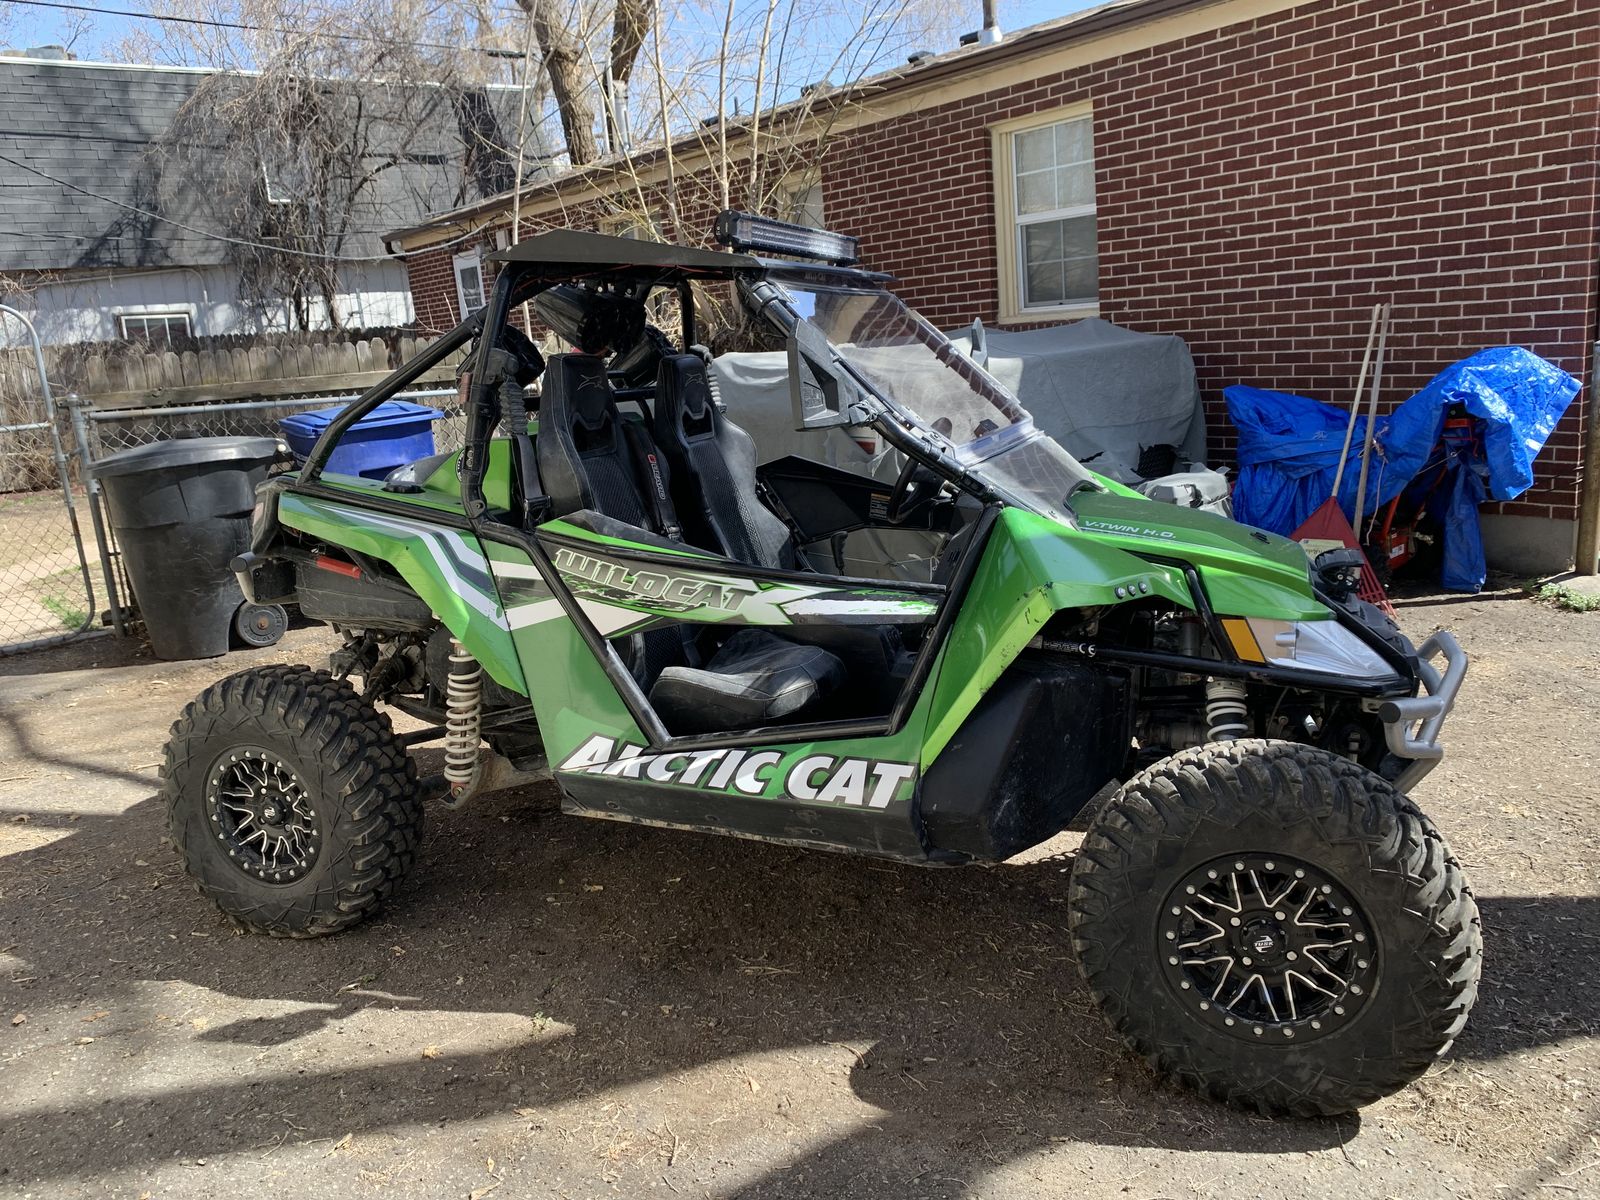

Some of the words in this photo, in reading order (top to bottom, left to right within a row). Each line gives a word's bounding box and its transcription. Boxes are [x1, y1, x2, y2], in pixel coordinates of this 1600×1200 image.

[1084, 520, 1140, 533] V-TWIN
[1143, 528, 1177, 539] H.O.
[555, 548, 760, 611] WILDCAT
[558, 734, 782, 795] ARCTIC
[785, 755, 917, 809] CAT
